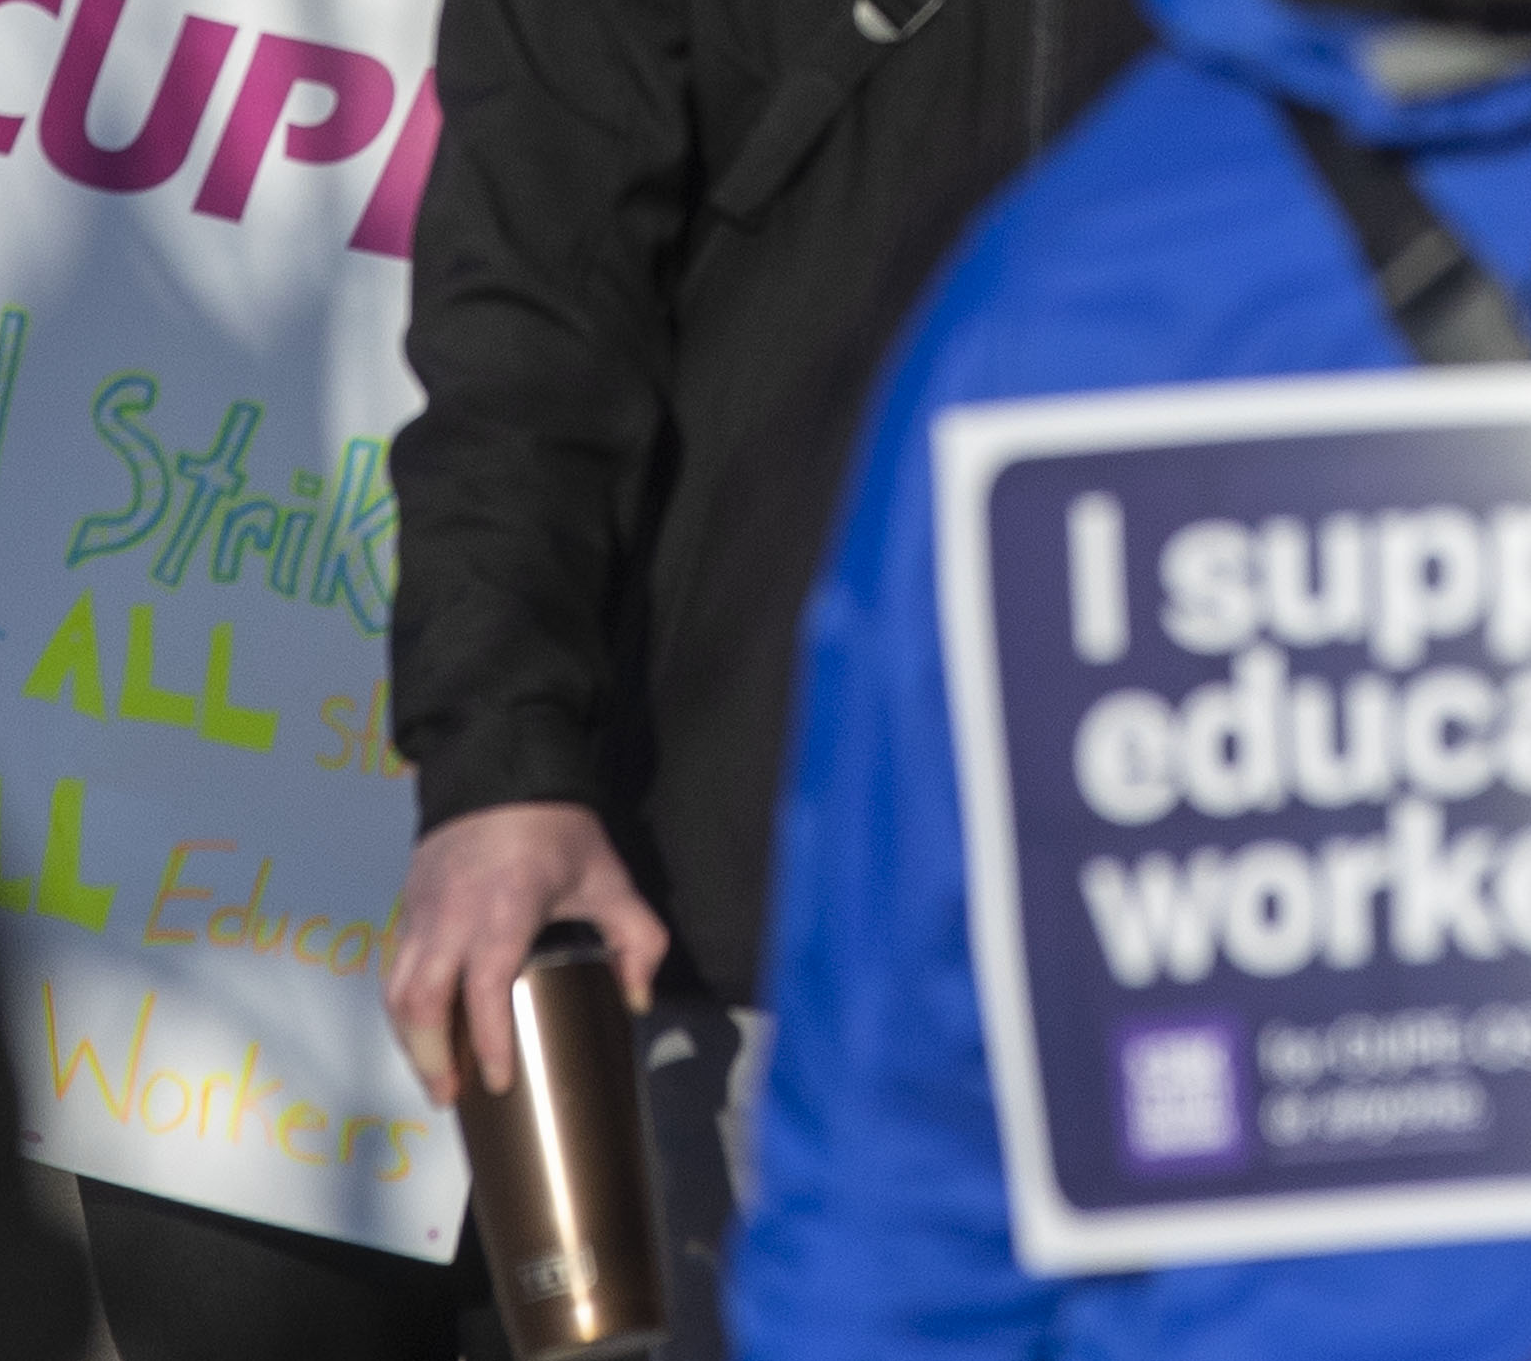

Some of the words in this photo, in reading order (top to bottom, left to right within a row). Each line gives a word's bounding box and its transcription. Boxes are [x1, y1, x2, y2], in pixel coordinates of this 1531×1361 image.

[66, 368, 402, 636] Strik
[1069, 485, 1131, 668] I
[21, 584, 280, 756] ALL
[41, 978, 431, 1185] Workers
